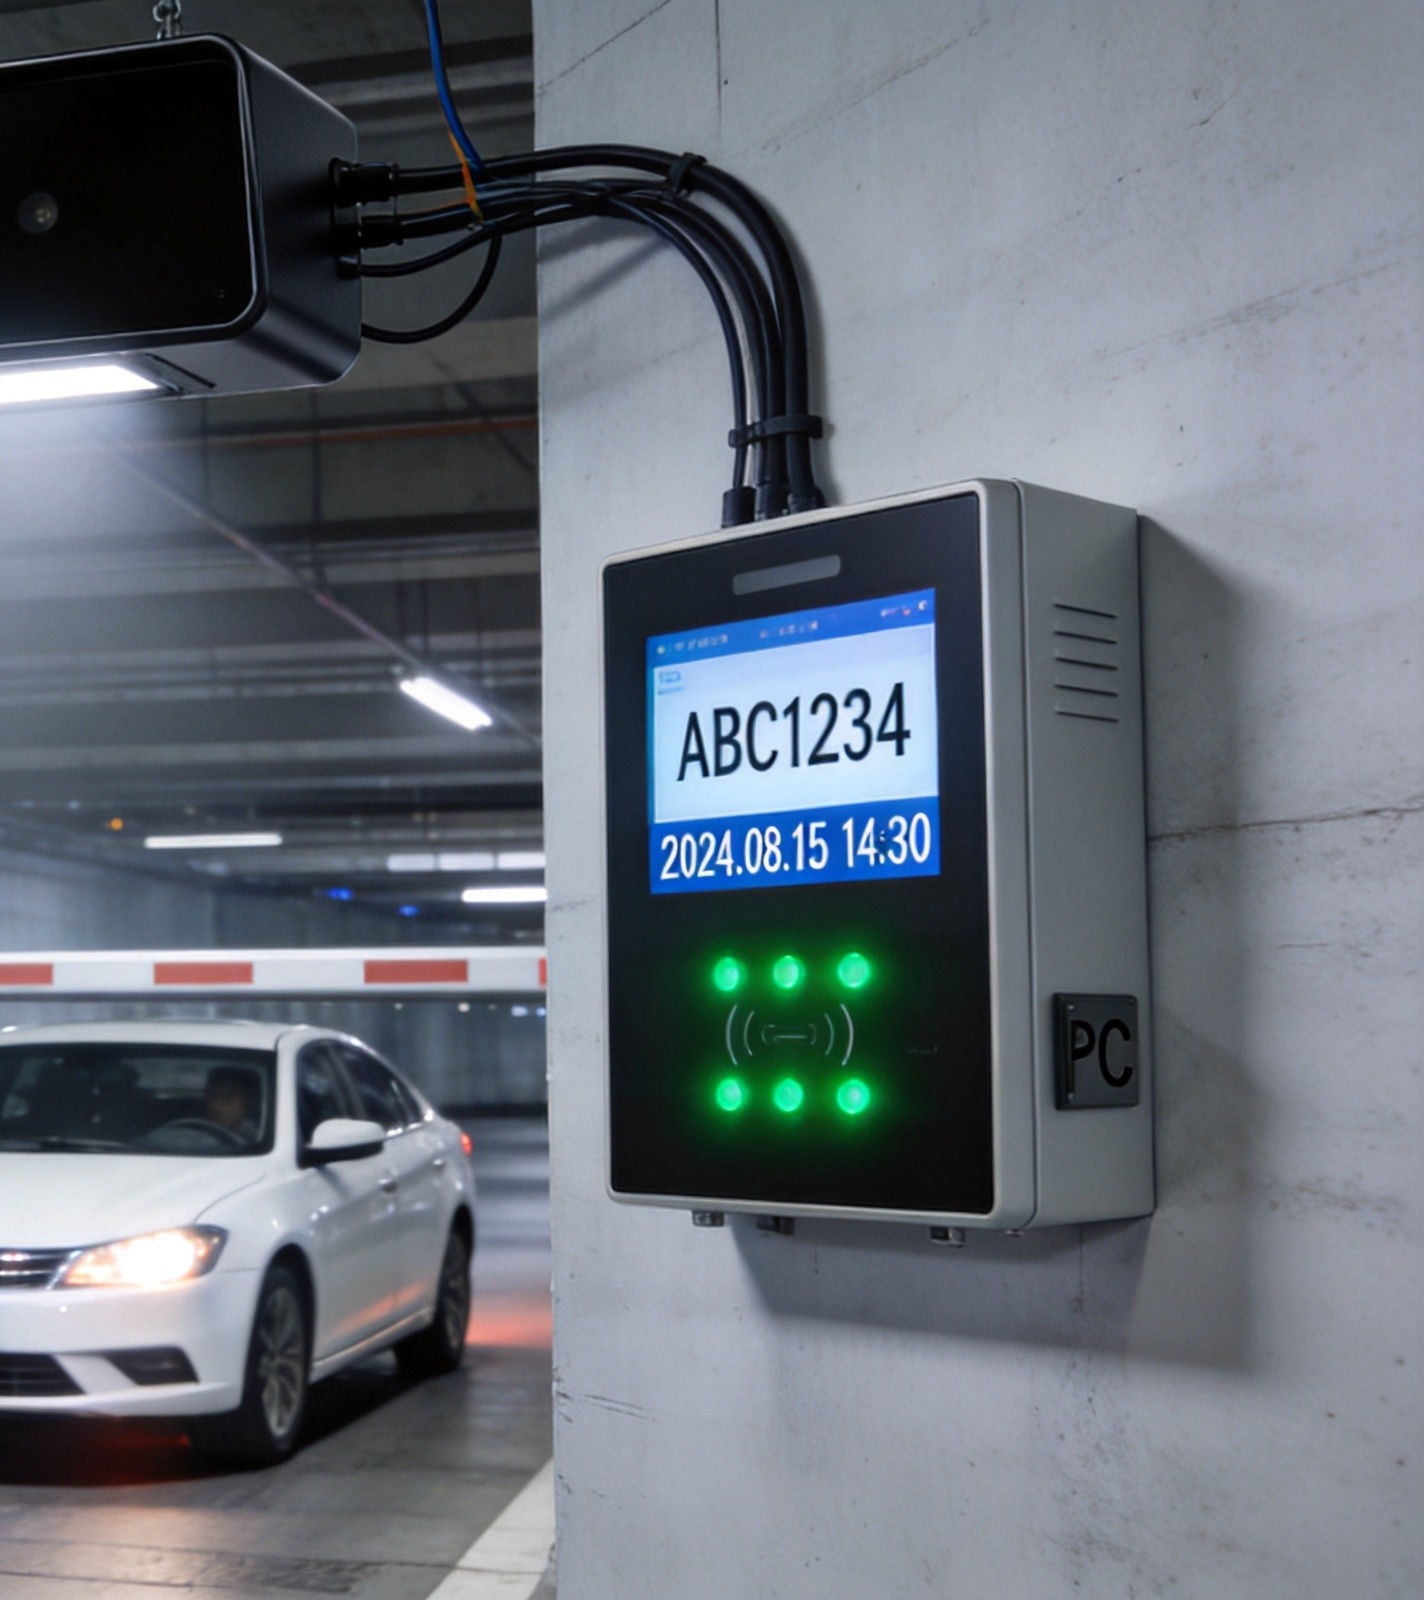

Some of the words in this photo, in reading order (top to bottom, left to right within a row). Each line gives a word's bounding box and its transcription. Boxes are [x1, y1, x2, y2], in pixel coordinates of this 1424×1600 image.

[677, 682, 911, 781] ABC1234
[660, 821, 827, 880] 2024.08.15
[842, 811, 931, 868] 14:30
[1066, 1018, 1134, 1094] PC
